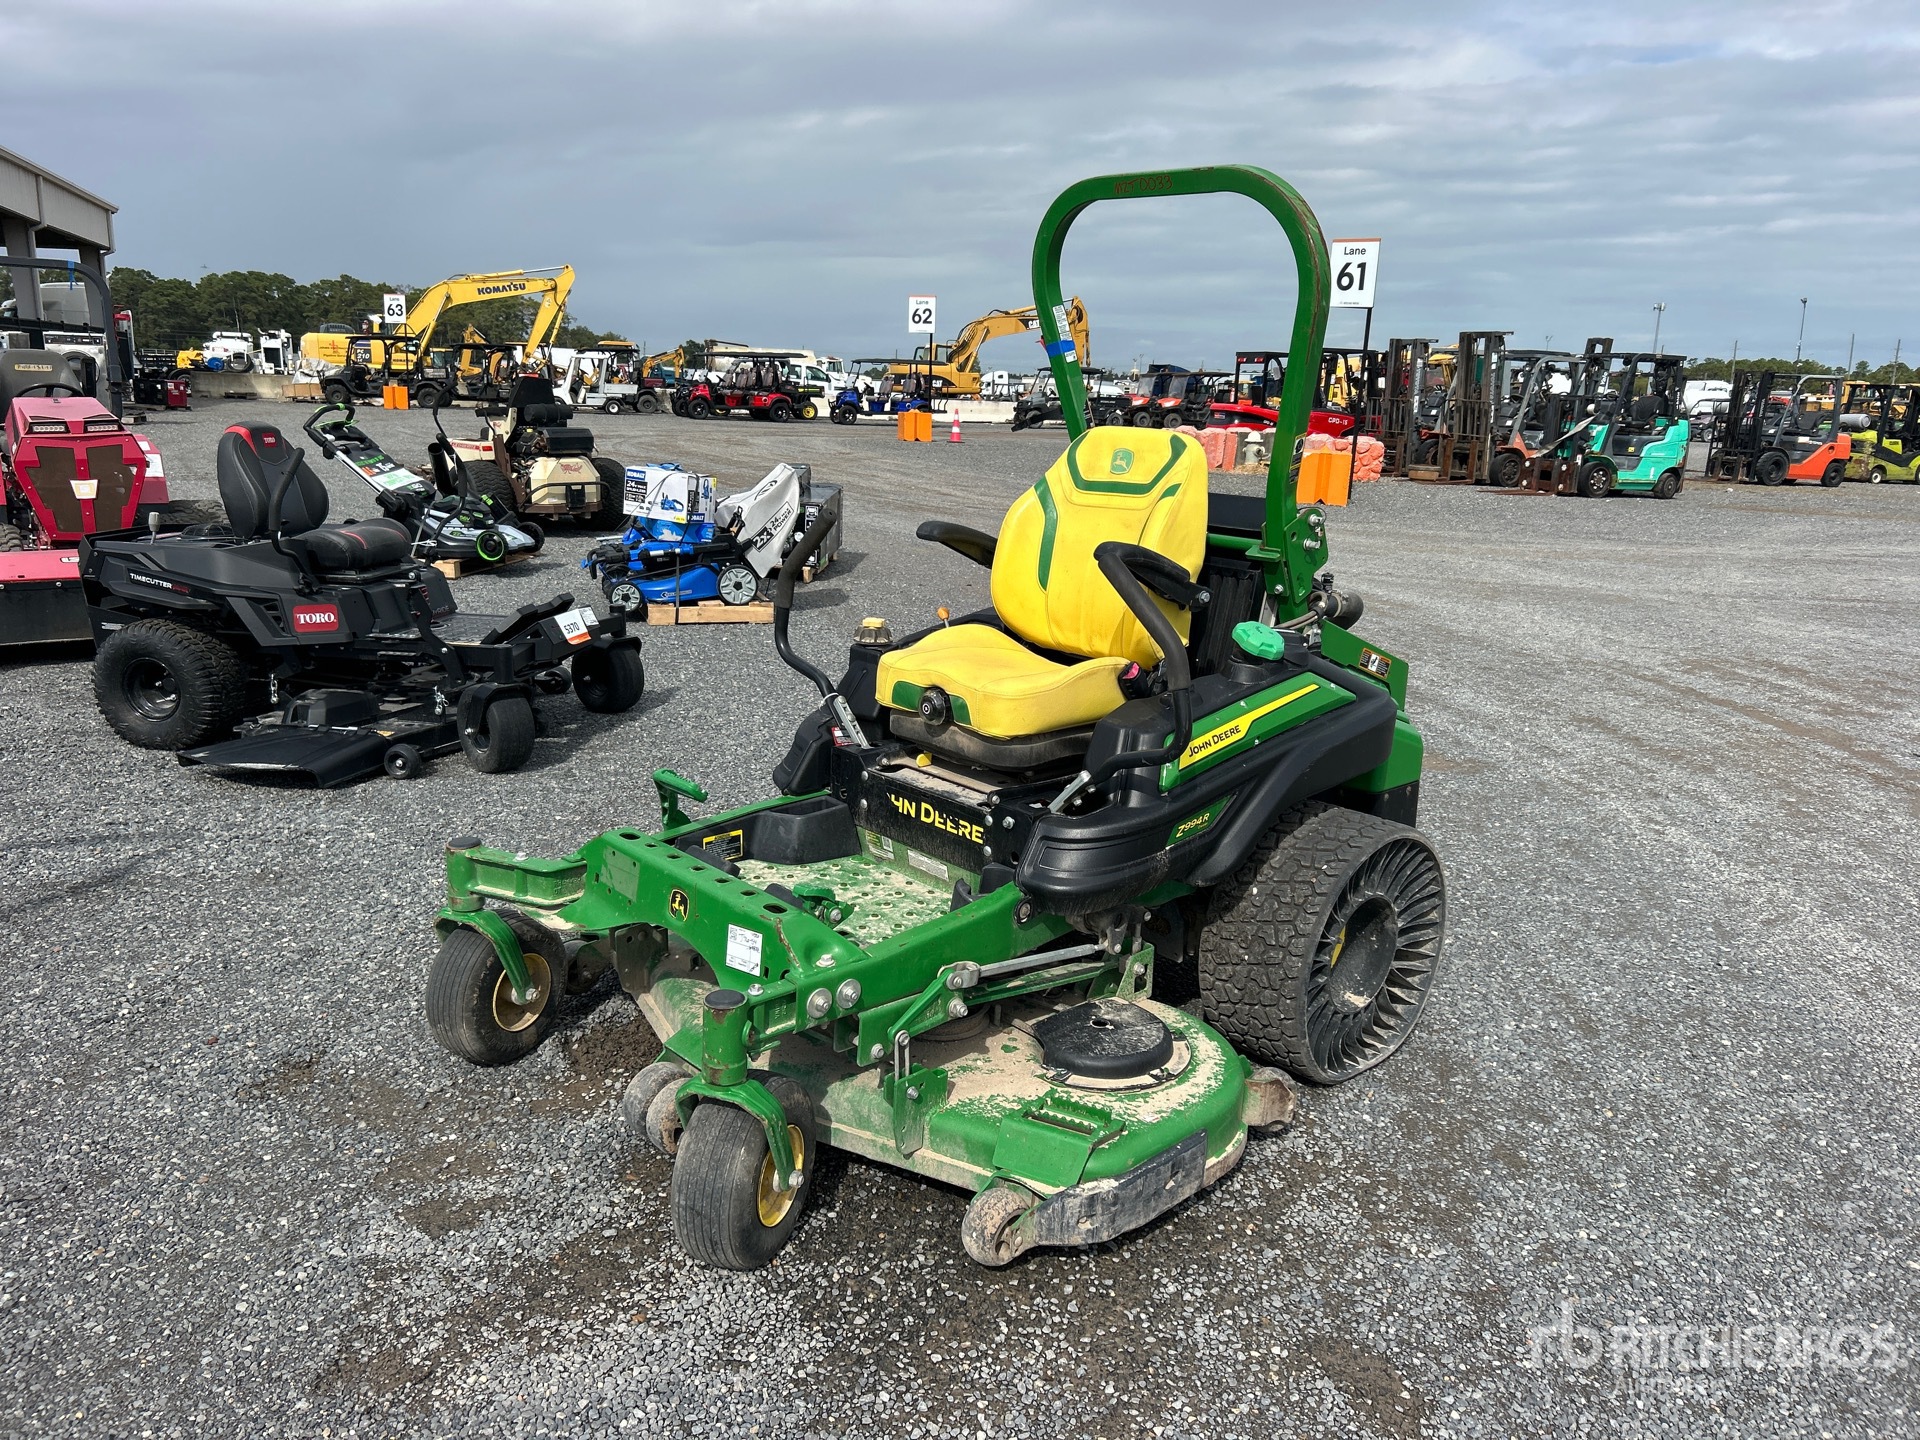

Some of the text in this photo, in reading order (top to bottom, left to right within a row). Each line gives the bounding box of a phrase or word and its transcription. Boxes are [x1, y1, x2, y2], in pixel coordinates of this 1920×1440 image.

[1344, 246, 1367, 255] Lane
[1336, 262, 1367, 291] 61
[477, 283, 526, 296] KOMATSU
[387, 303, 403, 317] 63
[912, 308, 933, 324] 62
[773, 510, 791, 531] POWER
[129, 573, 173, 590] TIMECUTTER
[296, 612, 335, 625] TORO
[564, 622, 580, 634] 5370
[1188, 725, 1242, 757] JOHN DEERE
[920, 802, 984, 844] DEERE
[1176, 813, 1210, 838] Z994R
